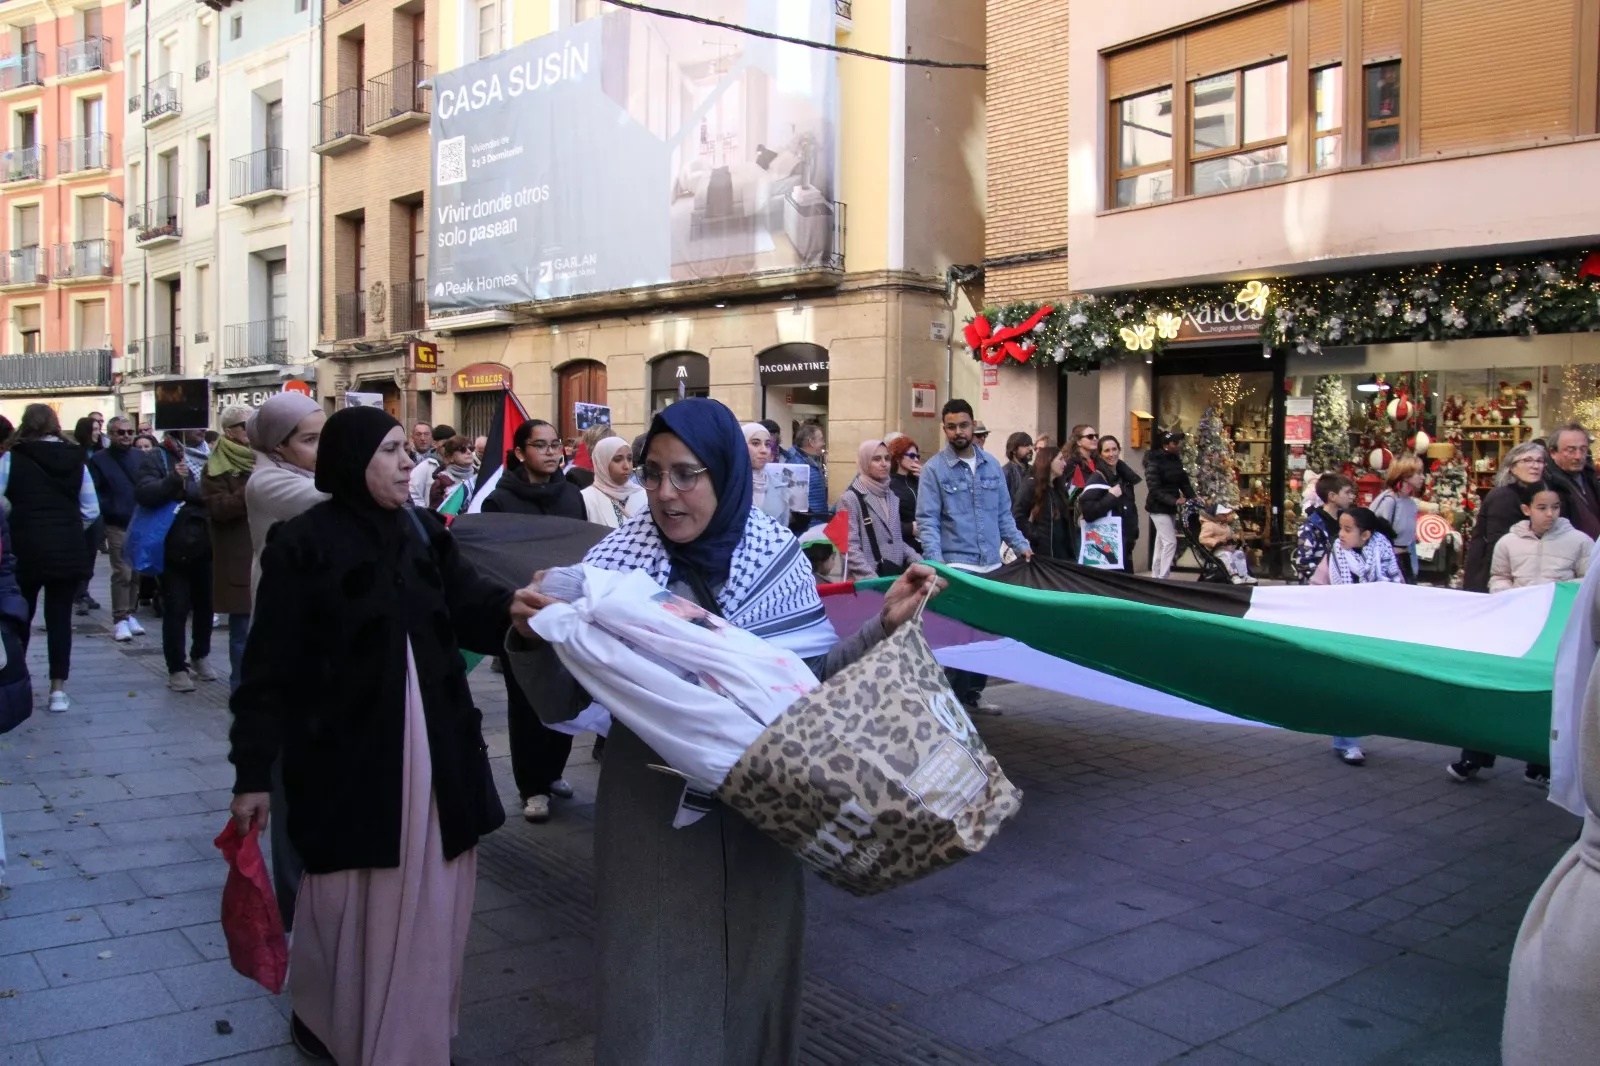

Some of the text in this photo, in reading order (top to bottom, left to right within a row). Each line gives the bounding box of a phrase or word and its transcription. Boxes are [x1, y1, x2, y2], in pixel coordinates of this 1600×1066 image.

[438, 40, 589, 120] CASA SUSÍN
[481, 156, 486, 165] 3
[438, 184, 550, 225] Vivir donde otros
[438, 217, 518, 248] solo pasean
[554, 254, 597, 270] GARLAN
[445, 273, 518, 295] Peak Homes
[760, 361, 830, 373] PACOMARTINEZ
[472, 374, 503, 384] TABACOS
[217, 392, 249, 407] HOME
